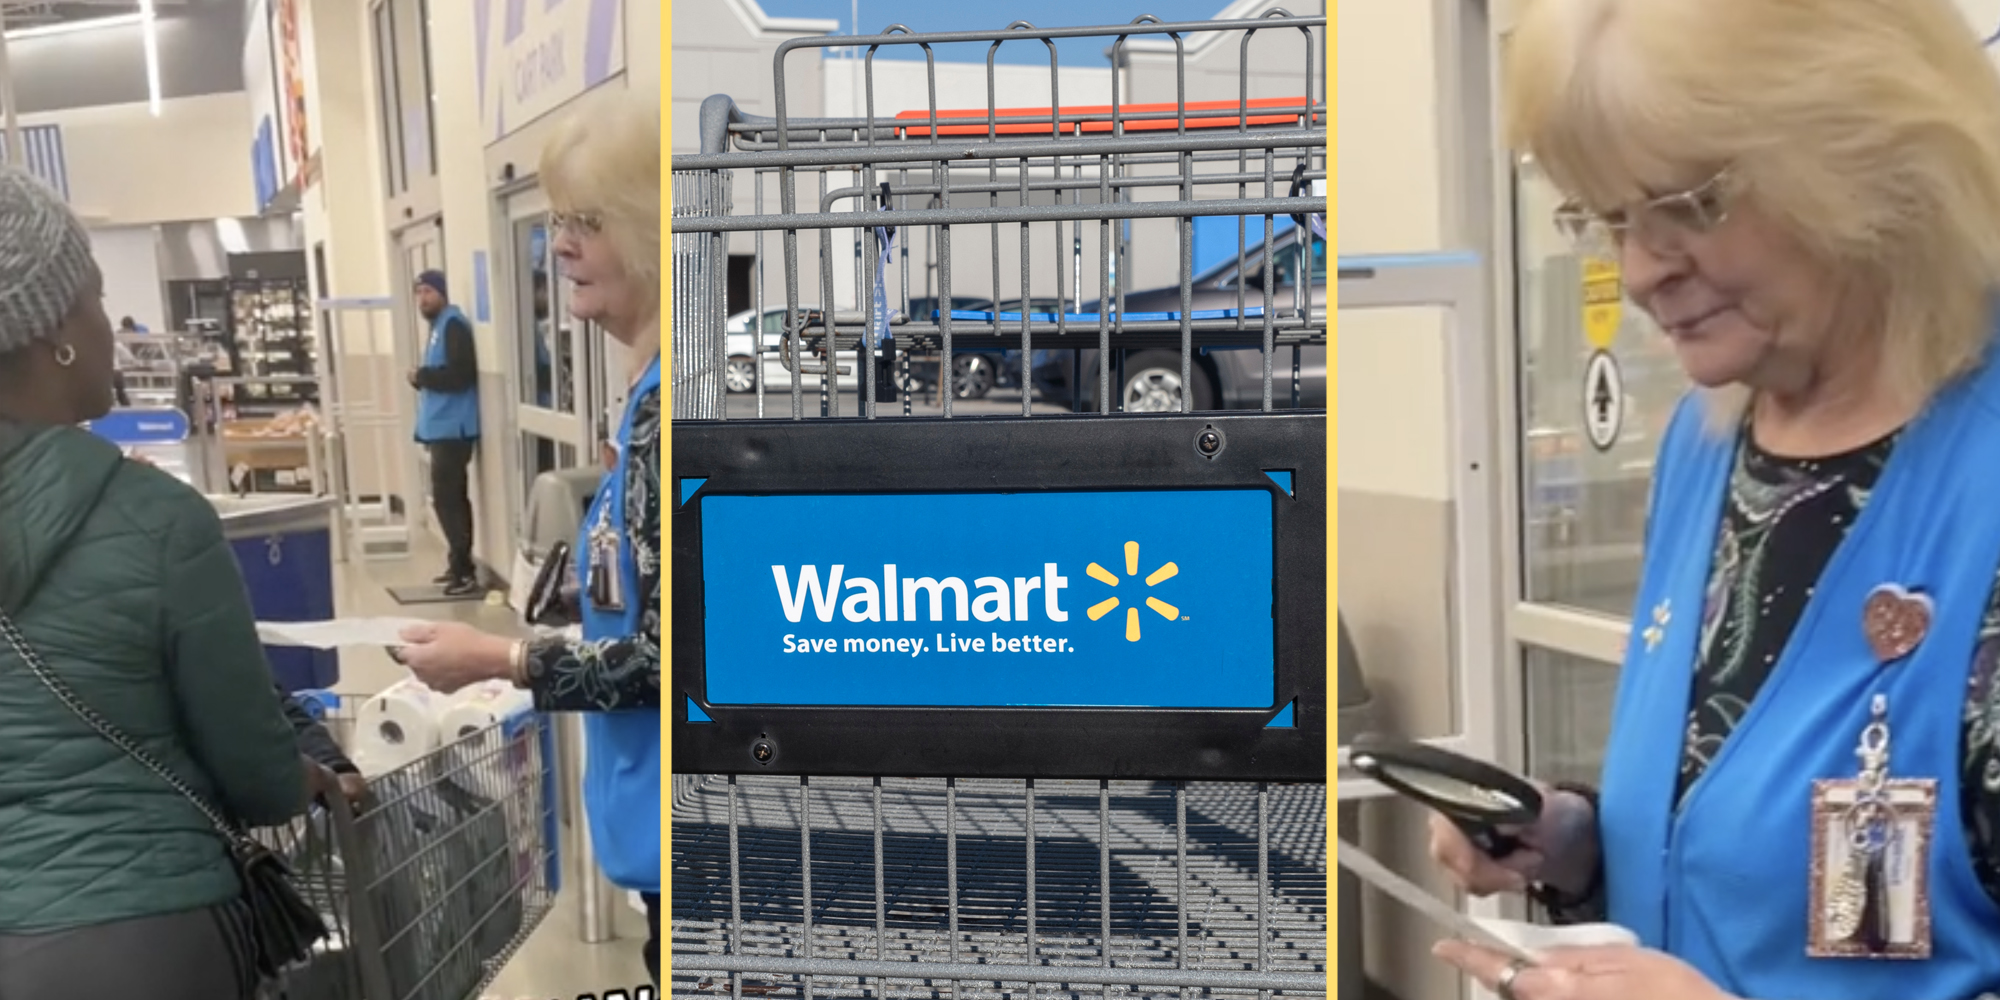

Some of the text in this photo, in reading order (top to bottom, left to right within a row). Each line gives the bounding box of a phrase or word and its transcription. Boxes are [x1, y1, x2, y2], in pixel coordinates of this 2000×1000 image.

[771, 563, 1069, 623] Walmart
[782, 632, 1075, 658] Save money. Live better.
